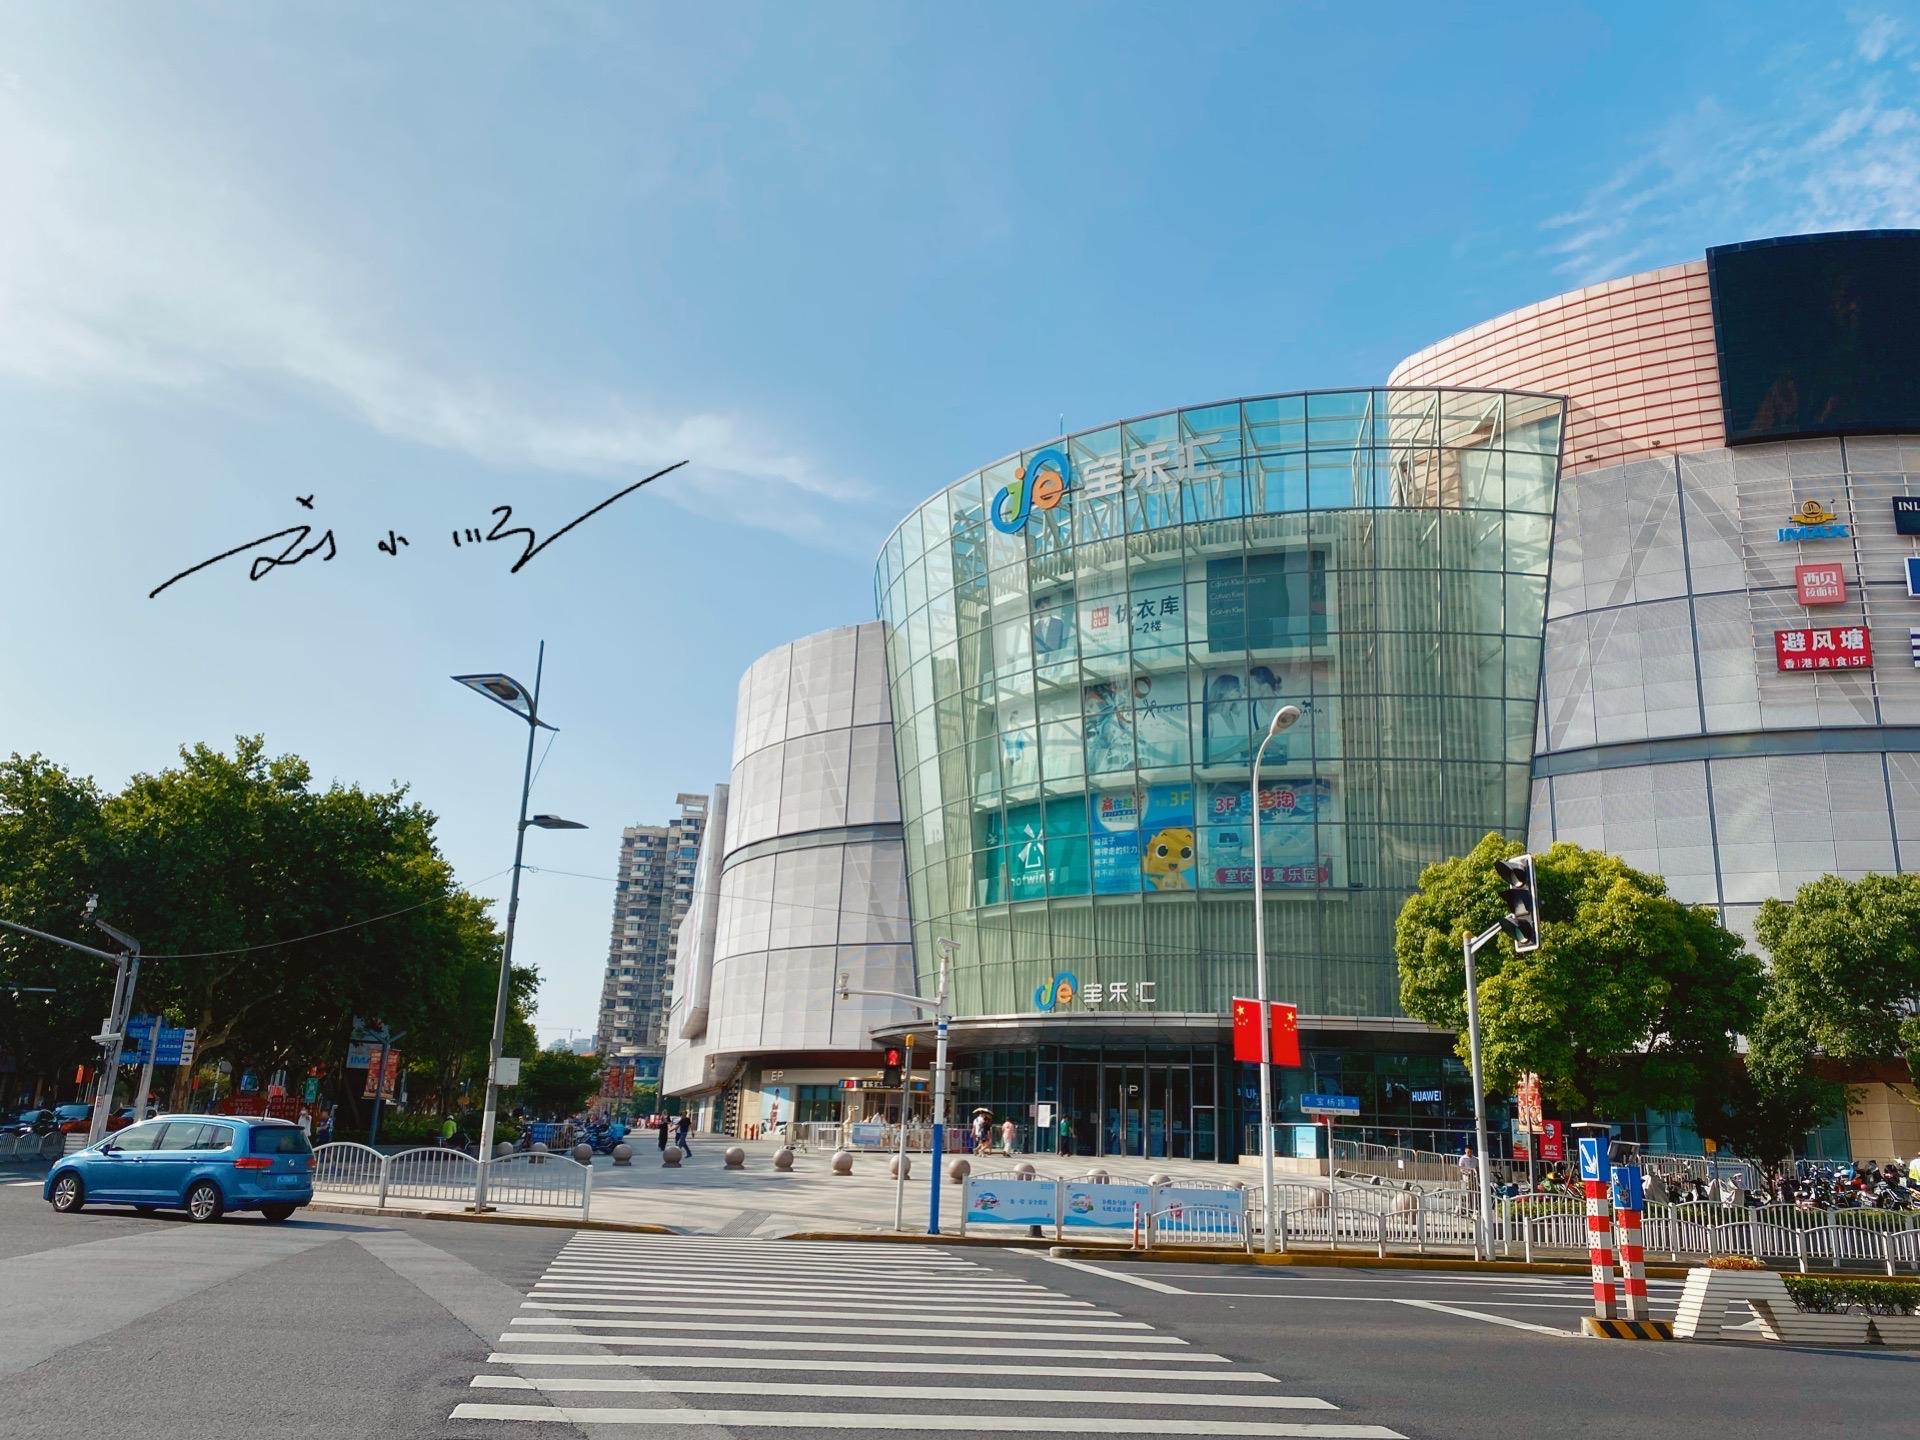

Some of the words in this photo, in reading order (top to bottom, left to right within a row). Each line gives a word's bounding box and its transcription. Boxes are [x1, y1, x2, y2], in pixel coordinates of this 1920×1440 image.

[1777, 525, 1849, 541] IMAX
[1803, 571, 1837, 587] 西贝
[1781, 628, 1864, 652] 避风塘
[1215, 797, 1236, 812] 3F
[1083, 982, 1156, 1003] 宝乐汇
[771, 1071, 784, 1081] EP
[1411, 1090, 1442, 1102] HUAWEI
